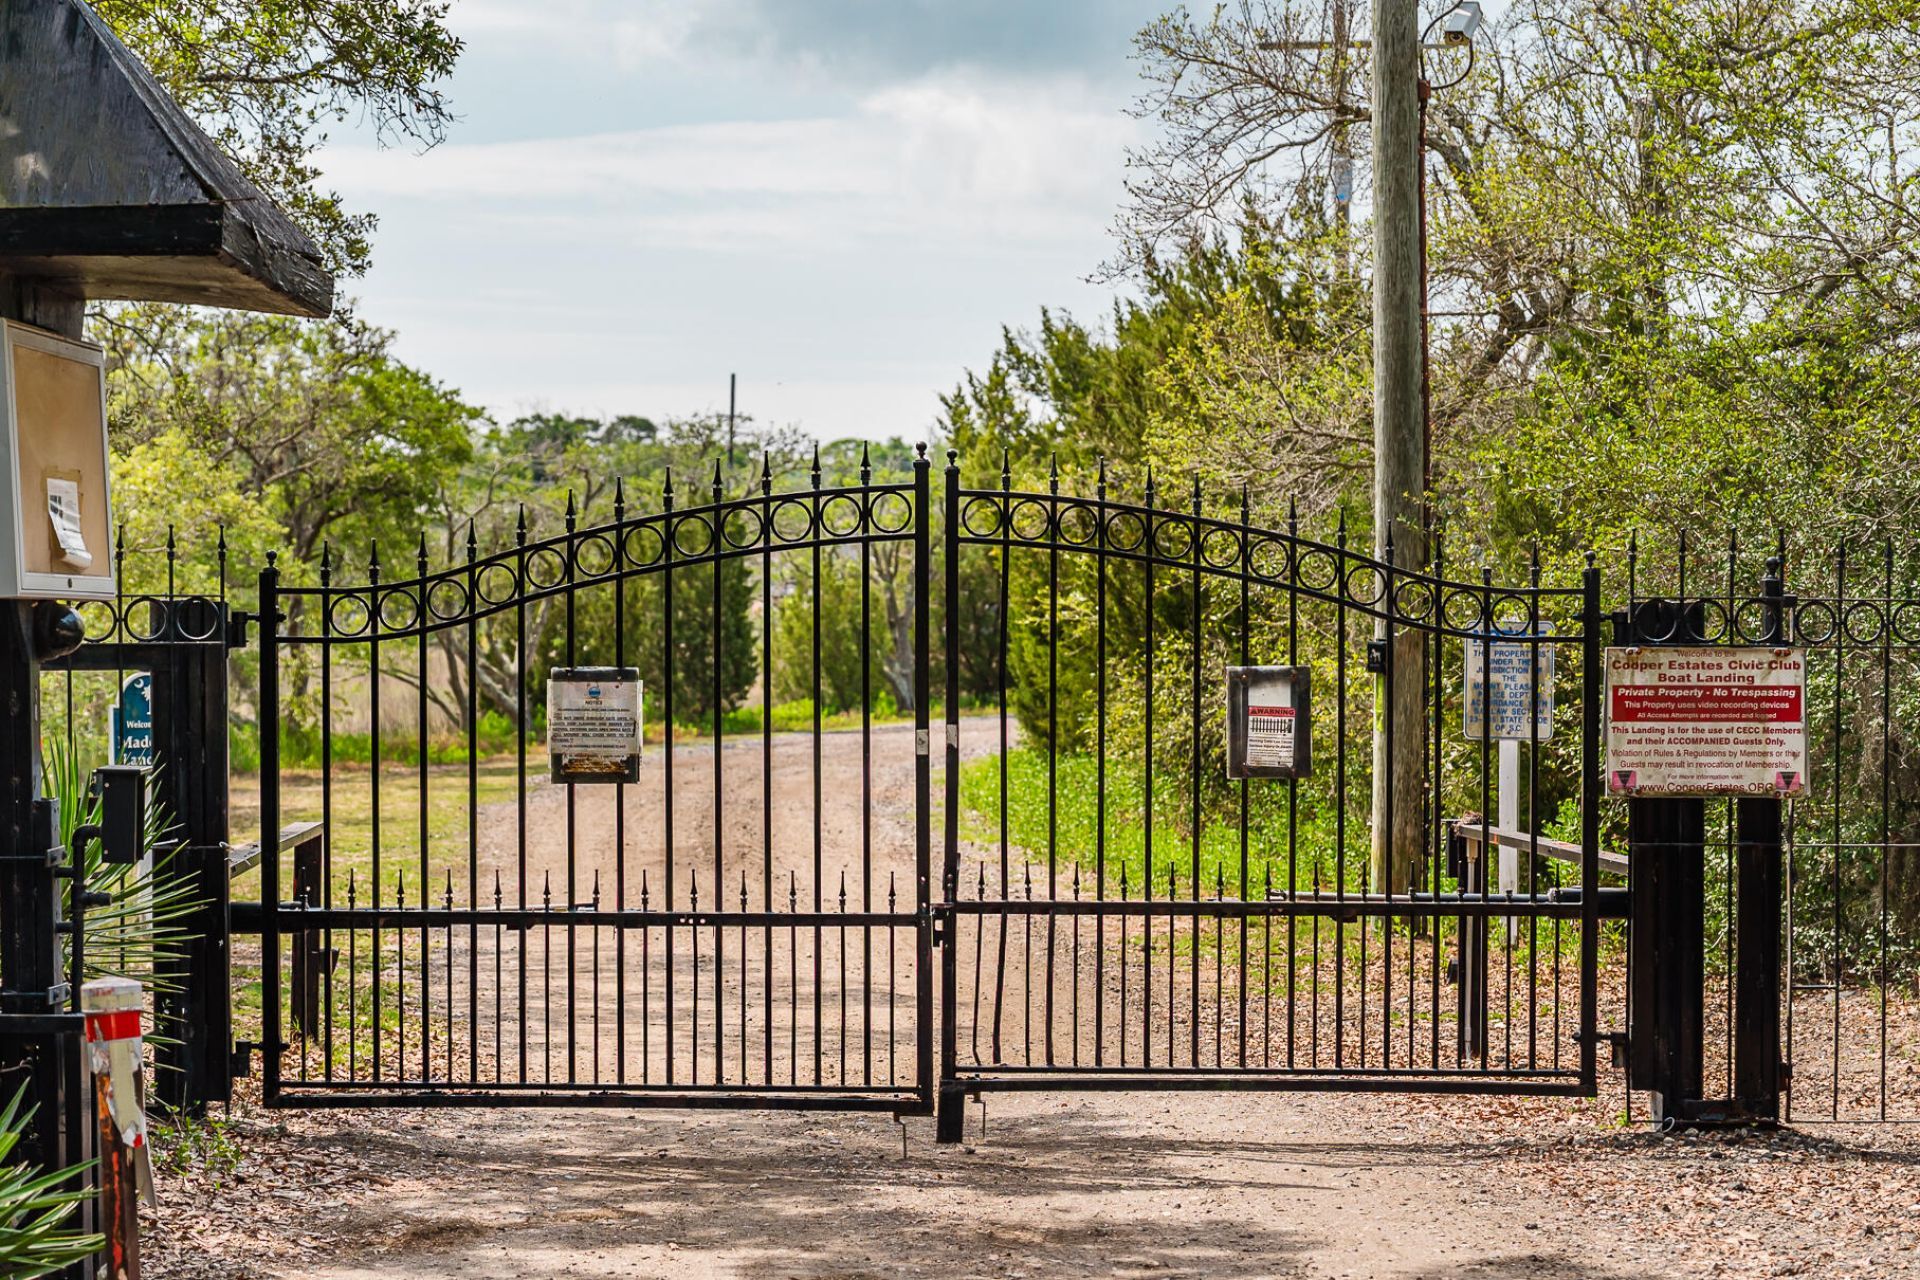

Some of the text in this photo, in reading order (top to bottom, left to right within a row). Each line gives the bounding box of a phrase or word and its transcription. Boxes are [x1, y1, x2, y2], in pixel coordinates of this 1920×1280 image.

[1612, 660, 1801, 672] Cooper Estates Civic Club
[1658, 673, 1755, 684] Boat Landing
[1618, 688, 1655, 696] Private
[1658, 688, 1703, 698] Property
[1713, 688, 1728, 696] No
[1731, 688, 1796, 698] Trespassing
[1720, 701, 1758, 709] recording
[1632, 727, 1665, 735] Landing
[1765, 738, 1786, 747] Only.
[1683, 750, 1726, 758] Regulations
[1728, 750, 1738, 759] by
[1745, 761, 1791, 769] Membership.
